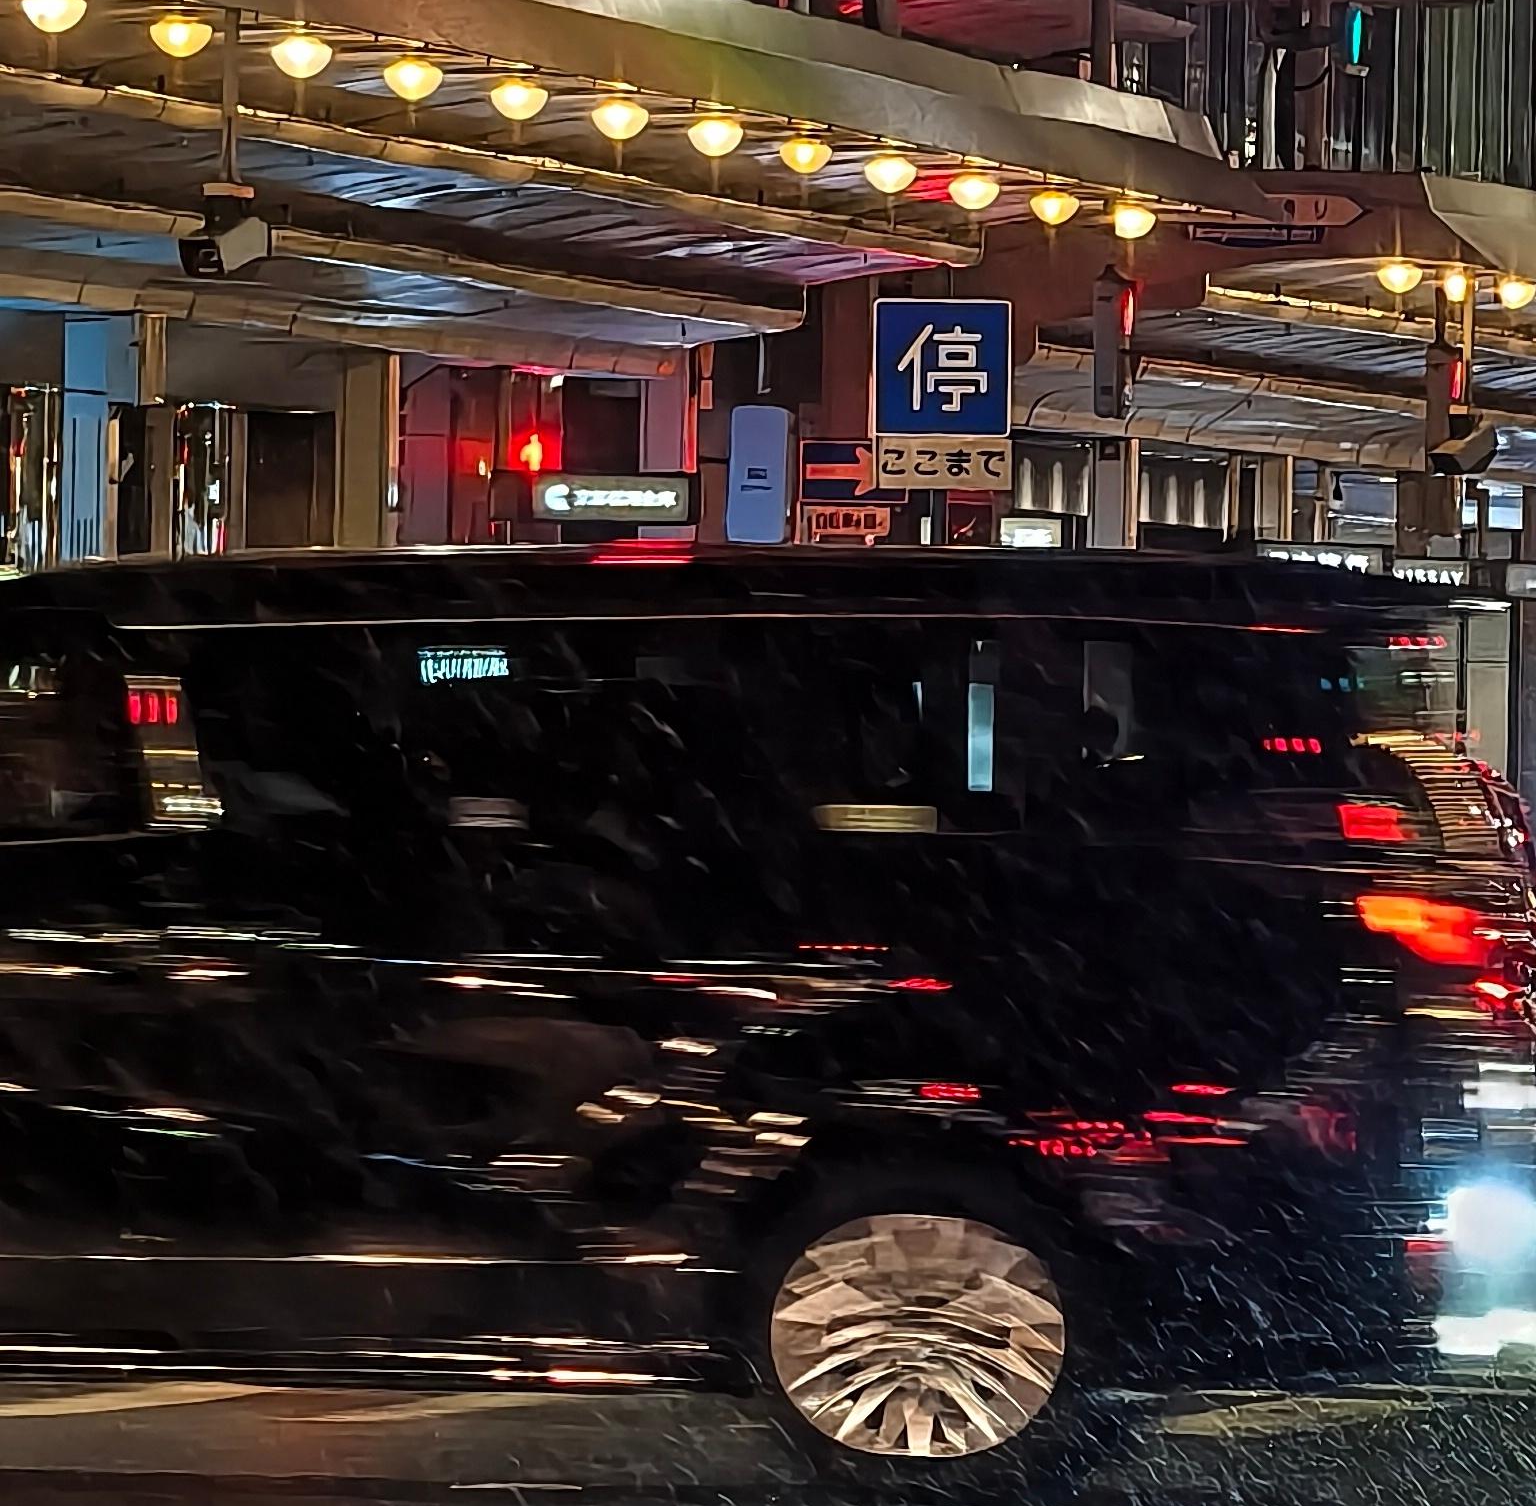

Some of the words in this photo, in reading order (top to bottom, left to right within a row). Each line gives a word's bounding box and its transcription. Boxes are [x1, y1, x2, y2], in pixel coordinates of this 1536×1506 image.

[897, 323, 988, 412] 停
[881, 447, 1006, 478] ここまで
